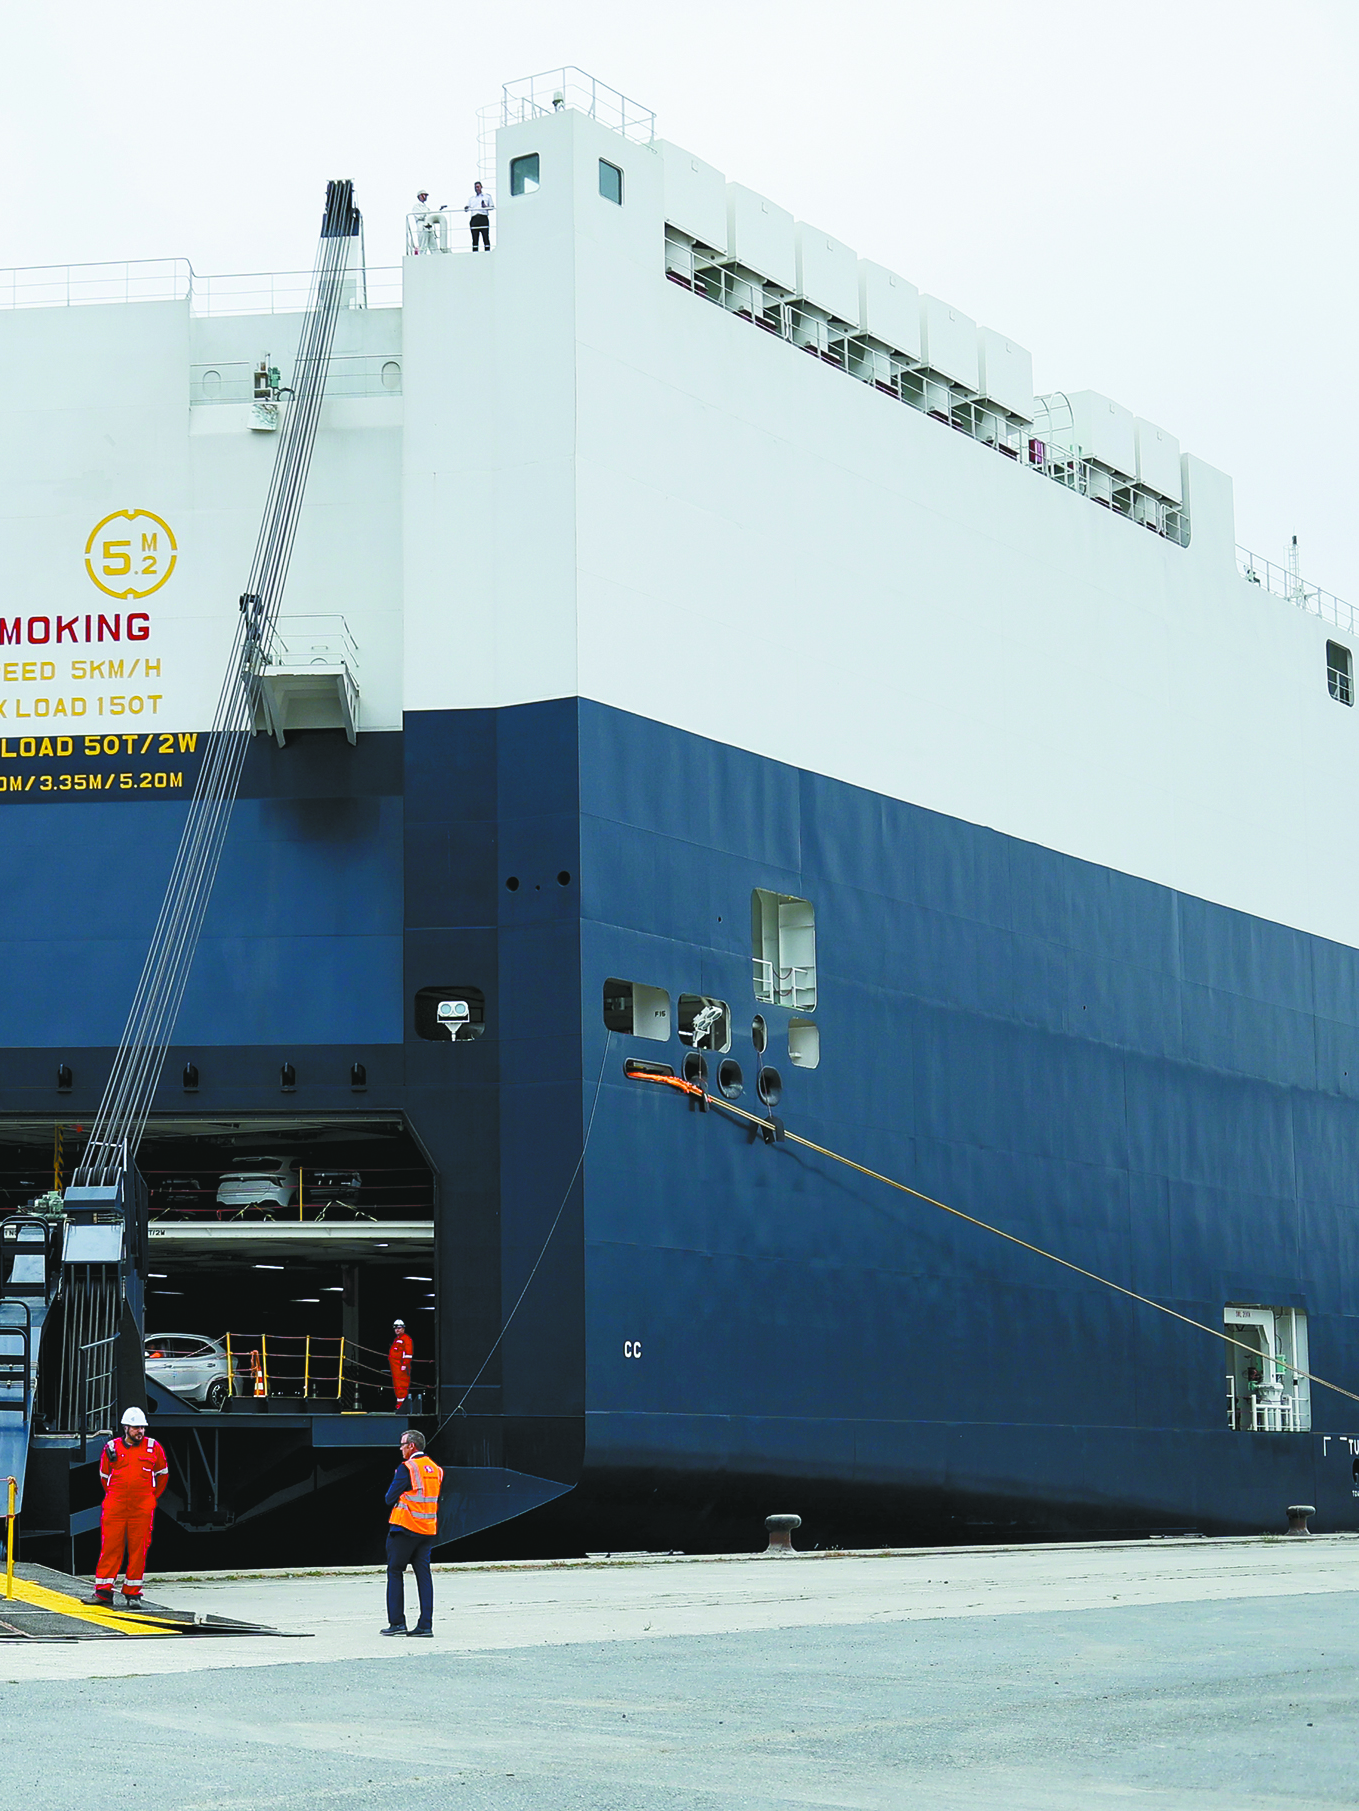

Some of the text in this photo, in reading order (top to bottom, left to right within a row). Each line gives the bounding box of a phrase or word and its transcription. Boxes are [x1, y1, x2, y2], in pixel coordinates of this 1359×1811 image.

[71, 658, 161, 680] 5KM/H
[16, 696, 87, 718] LOAD
[97, 694, 163, 716] 150T
[1, 736, 73, 758] LOAD
[84, 733, 198, 756] 50T/2W
